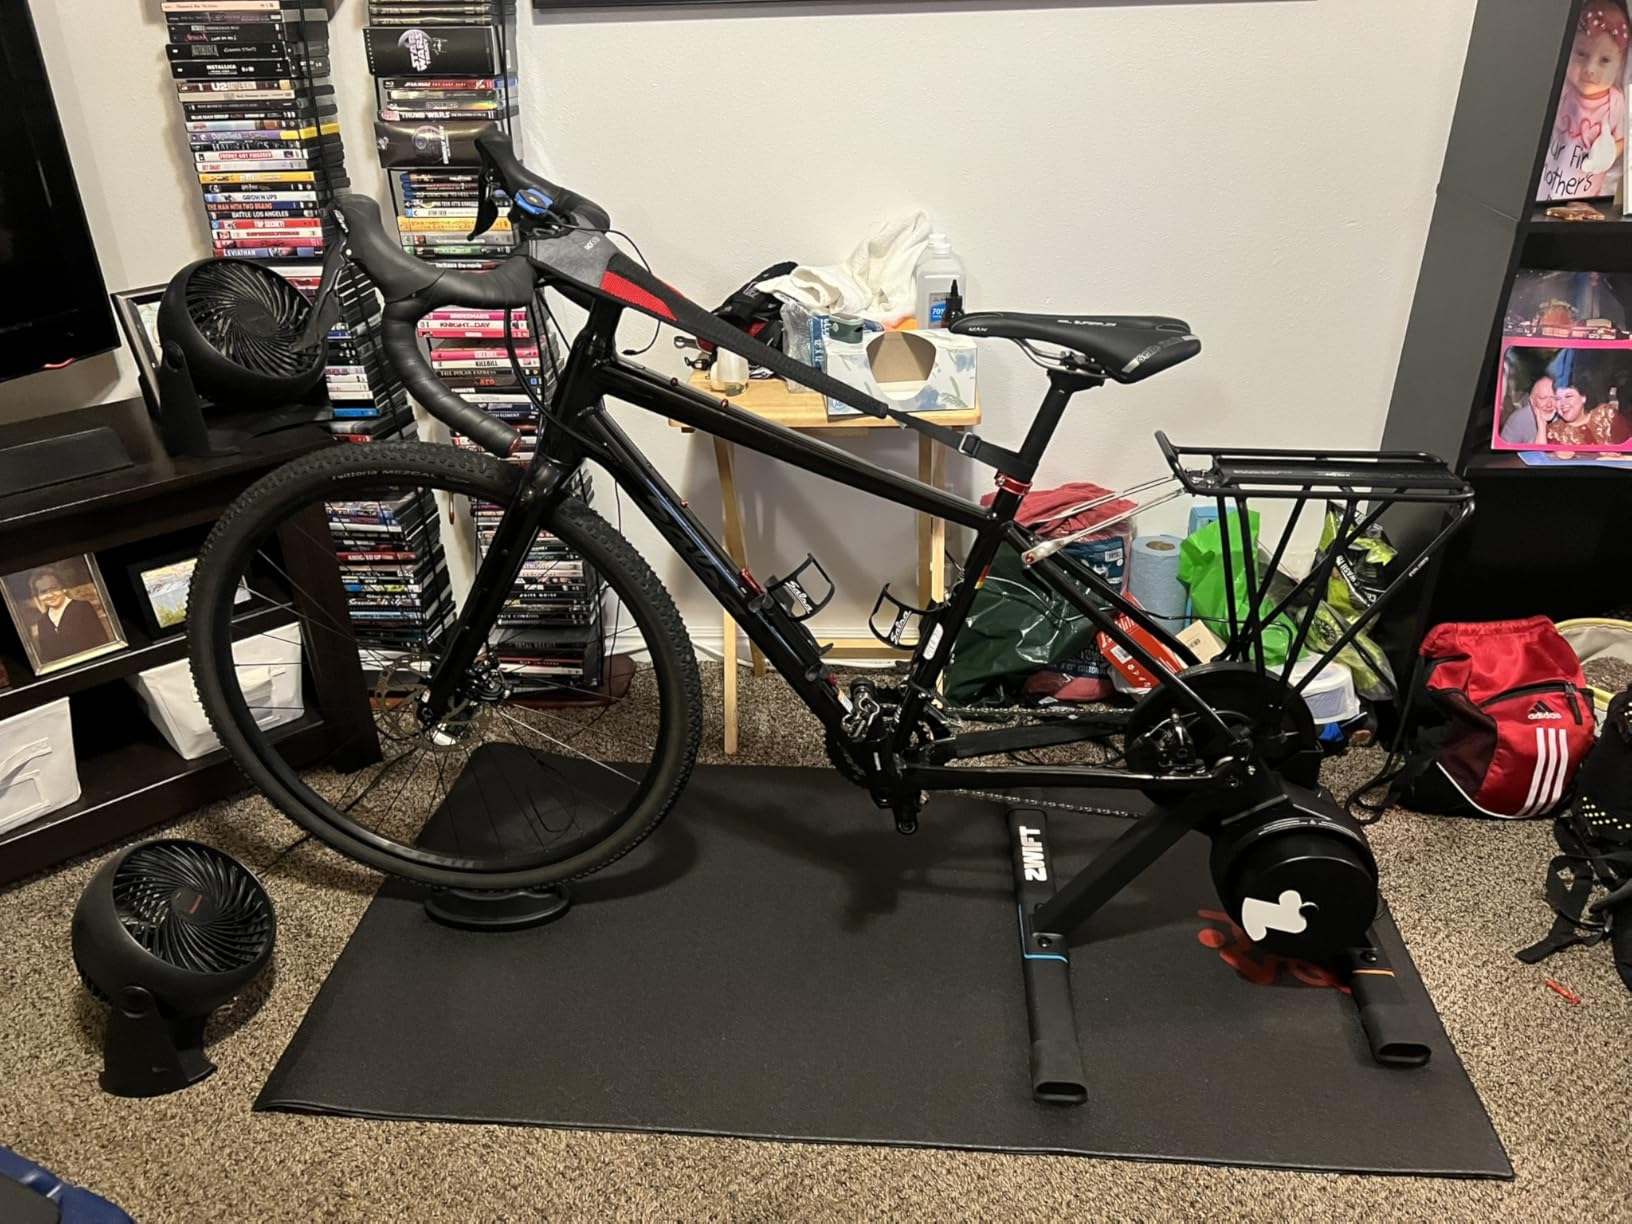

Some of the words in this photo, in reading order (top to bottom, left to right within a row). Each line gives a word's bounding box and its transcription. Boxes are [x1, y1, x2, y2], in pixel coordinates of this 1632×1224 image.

[408, 32, 419, 68] STAR
[414, 32, 429, 72] WARS
[211, 81, 228, 92] U2
[223, 248, 257, 257] LEVIATHAN
[784, 580, 815, 615] Salsa
[889, 610, 912, 646] Salsa
[1528, 712, 1562, 720] adidas
[1018, 826, 1048, 882] ZWIFT
